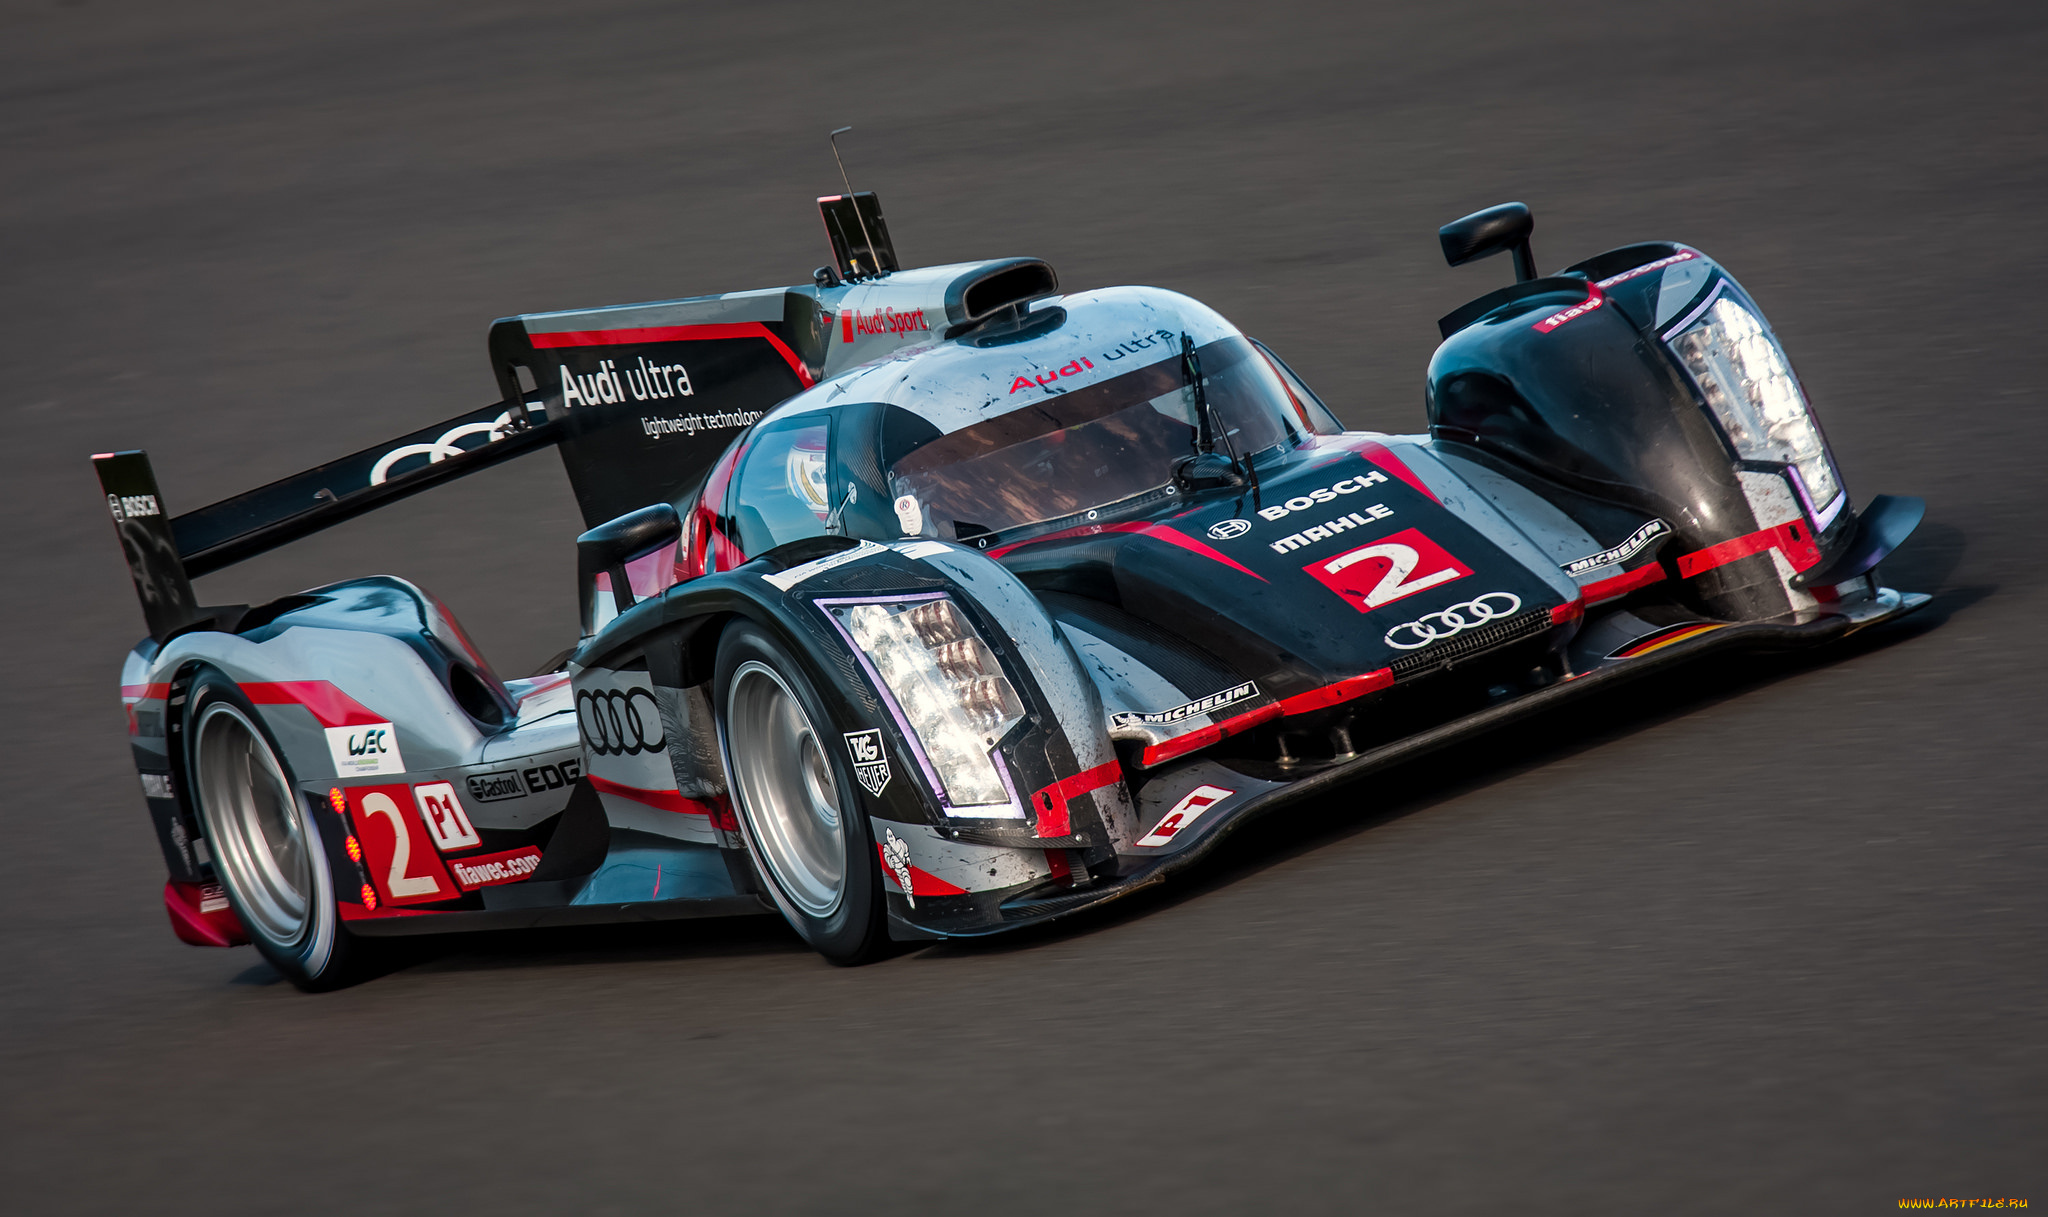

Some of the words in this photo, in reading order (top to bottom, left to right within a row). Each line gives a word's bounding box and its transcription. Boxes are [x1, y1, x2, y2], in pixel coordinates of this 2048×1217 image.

[856, 308, 886, 335] Audi
[886, 306, 927, 339] Sport
[1545, 297, 1602, 326] fiaw
[559, 359, 626, 408] Audi
[625, 356, 694, 401] ultra
[1009, 356, 1095, 395] Audi
[1103, 329, 1176, 361] ultra
[641, 412, 705, 439] lightweight
[703, 407, 764, 429] technolo
[1257, 470, 1389, 522] BOSCH
[1269, 503, 1394, 555] MAHLE
[1570, 522, 1661, 572] MICHELIN
[1323, 543, 1461, 608] 2
[1144, 684, 1250, 723] MICHELIN
[349, 729, 387, 756] WEC
[850, 734, 878, 762] TAG
[481, 775, 521, 797] Castrol
[523, 758, 580, 793] EDG
[856, 764, 888, 792] HEUER
[424, 794, 468, 839] P1
[1151, 795, 1217, 836] P1
[361, 792, 440, 898] 2
[453, 854, 541, 885] fiawec.com
